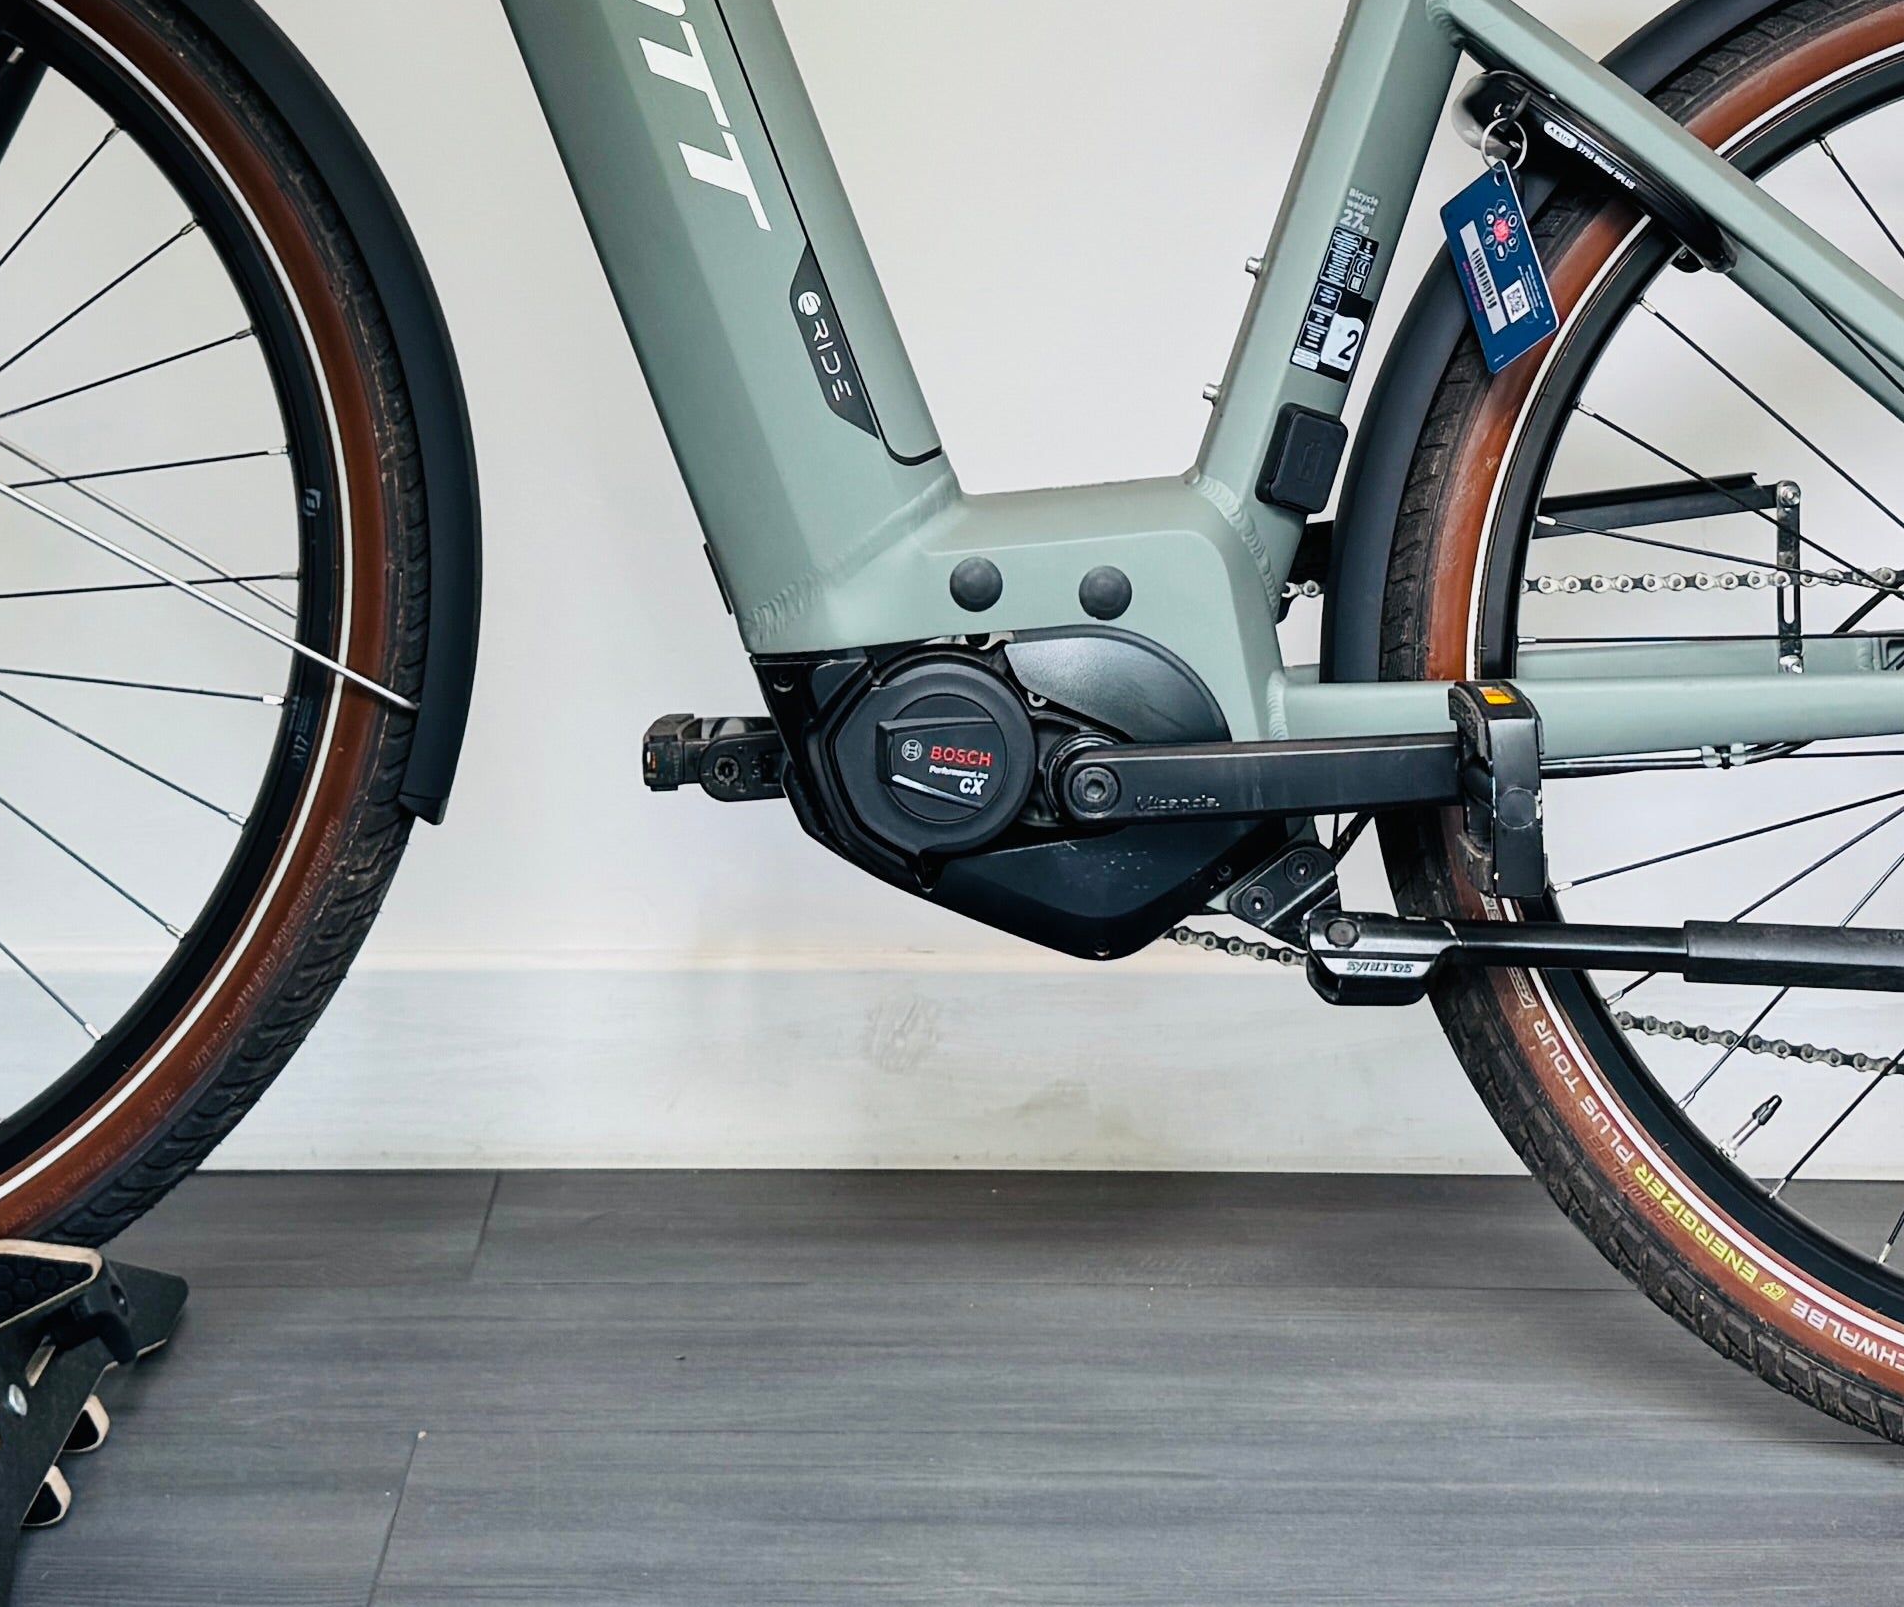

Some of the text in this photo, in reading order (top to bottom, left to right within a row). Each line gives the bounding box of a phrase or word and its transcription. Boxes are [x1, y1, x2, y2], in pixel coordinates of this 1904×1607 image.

[1337, 329, 1360, 361] 2
[929, 745, 993, 767] BOSCH
[959, 777, 985, 795] CX
[1533, 1019, 1581, 1094] TOUR
[1579, 1095, 1635, 1165] PLUS
[1634, 1163, 1760, 1284] ENERGIZER
